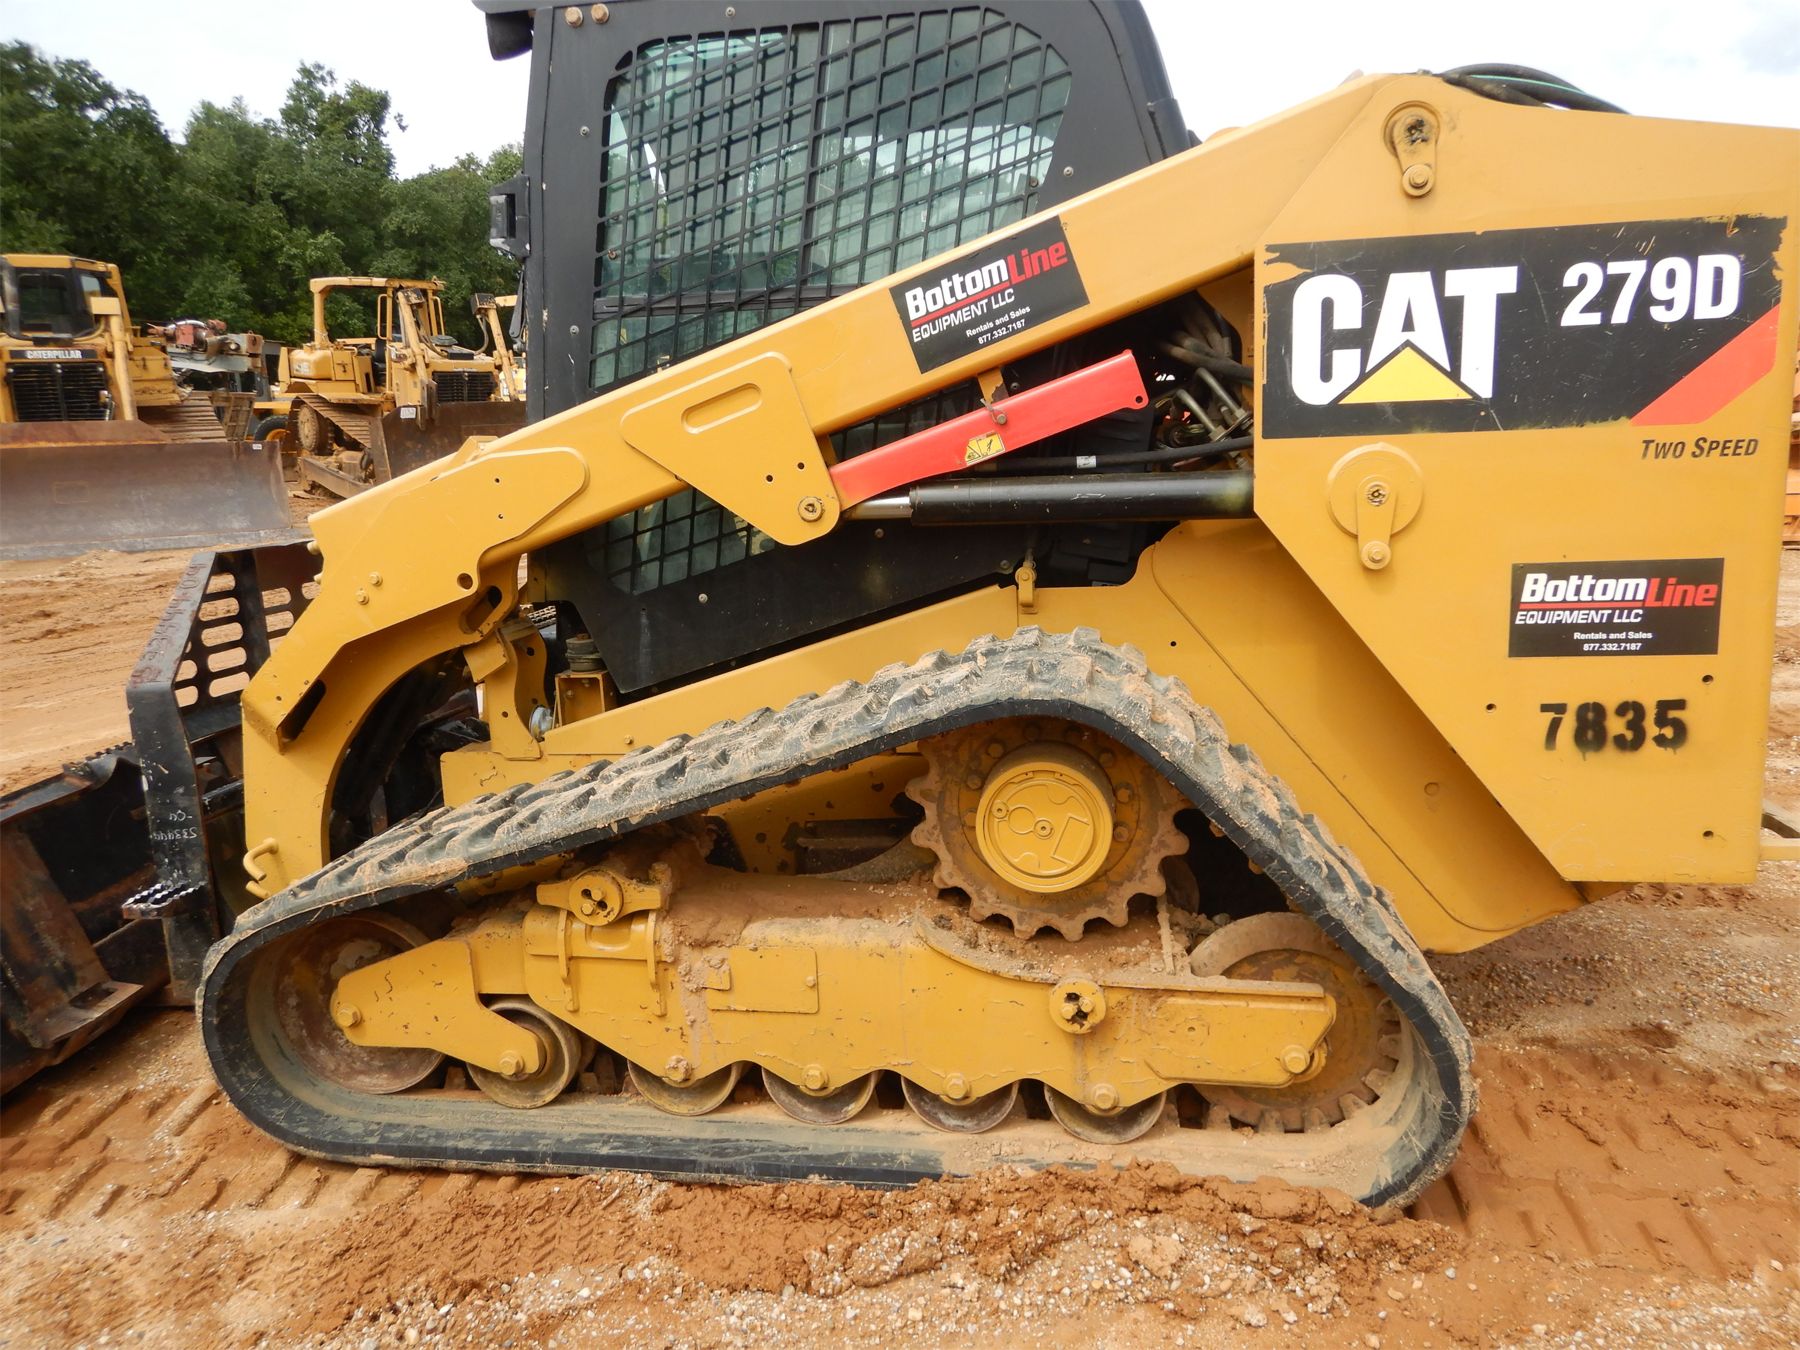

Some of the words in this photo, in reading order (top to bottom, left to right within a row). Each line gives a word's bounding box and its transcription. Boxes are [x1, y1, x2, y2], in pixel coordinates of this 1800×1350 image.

[1560, 254, 1741, 327] 279D
[912, 300, 990, 343] EQUIPMENT
[991, 288, 1015, 311] LLC
[966, 320, 994, 337] Rentals
[995, 313, 1009, 327] and
[1010, 305, 1031, 320] Sales
[978, 319, 1026, 345] 877.332.7187
[1291, 265, 1518, 406] CAT
[26, 350, 82, 359] CATERPILLAR
[1515, 610, 1611, 625] EQUIPMENT
[1612, 609, 1643, 623] LLC
[1573, 631, 1607, 640] Rentals
[1608, 631, 1626, 640] and
[1627, 631, 1653, 640] Sales
[1583, 642, 1642, 651] 877.332.7187
[1540, 699, 1688, 752] 7835
